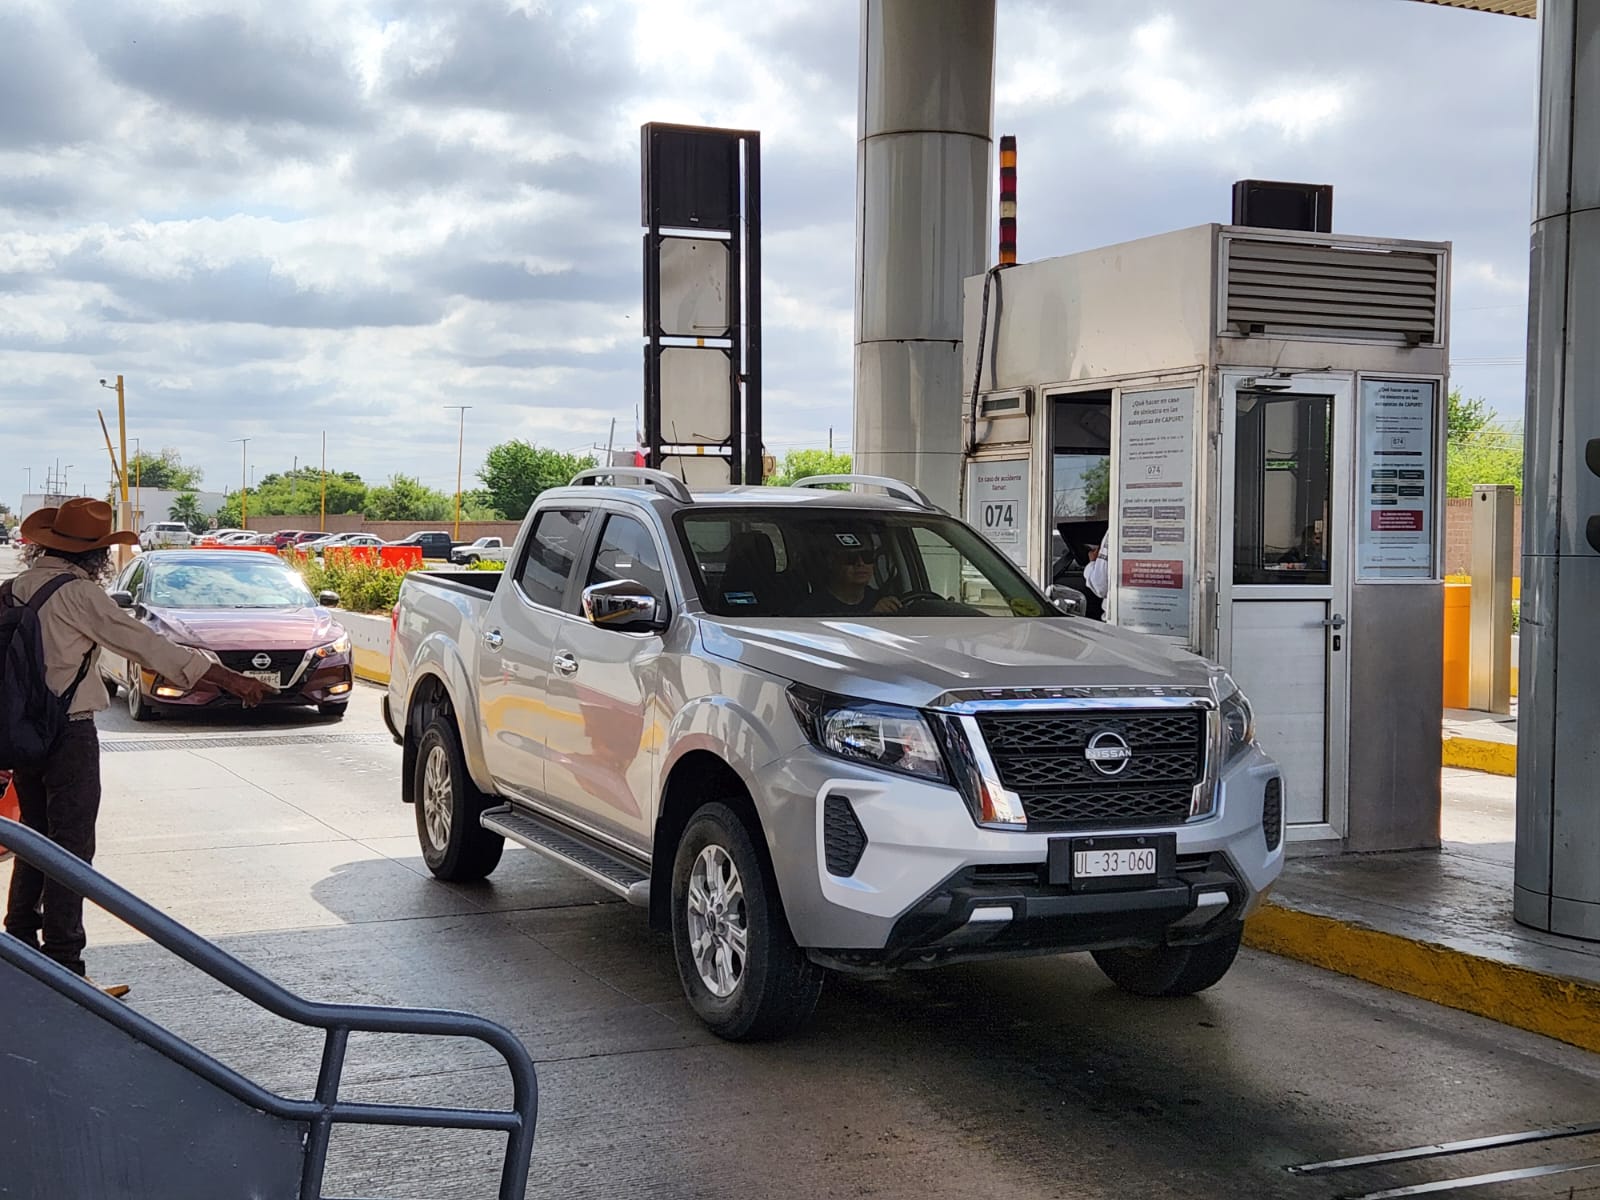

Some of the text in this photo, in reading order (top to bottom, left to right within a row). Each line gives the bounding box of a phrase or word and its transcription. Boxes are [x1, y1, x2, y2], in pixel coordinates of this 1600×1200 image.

[1147, 466, 1161, 475] 074
[1001, 474, 1021, 482] accidente
[985, 504, 1014, 528] 074
[1087, 749, 1132, 758] NISSAN
